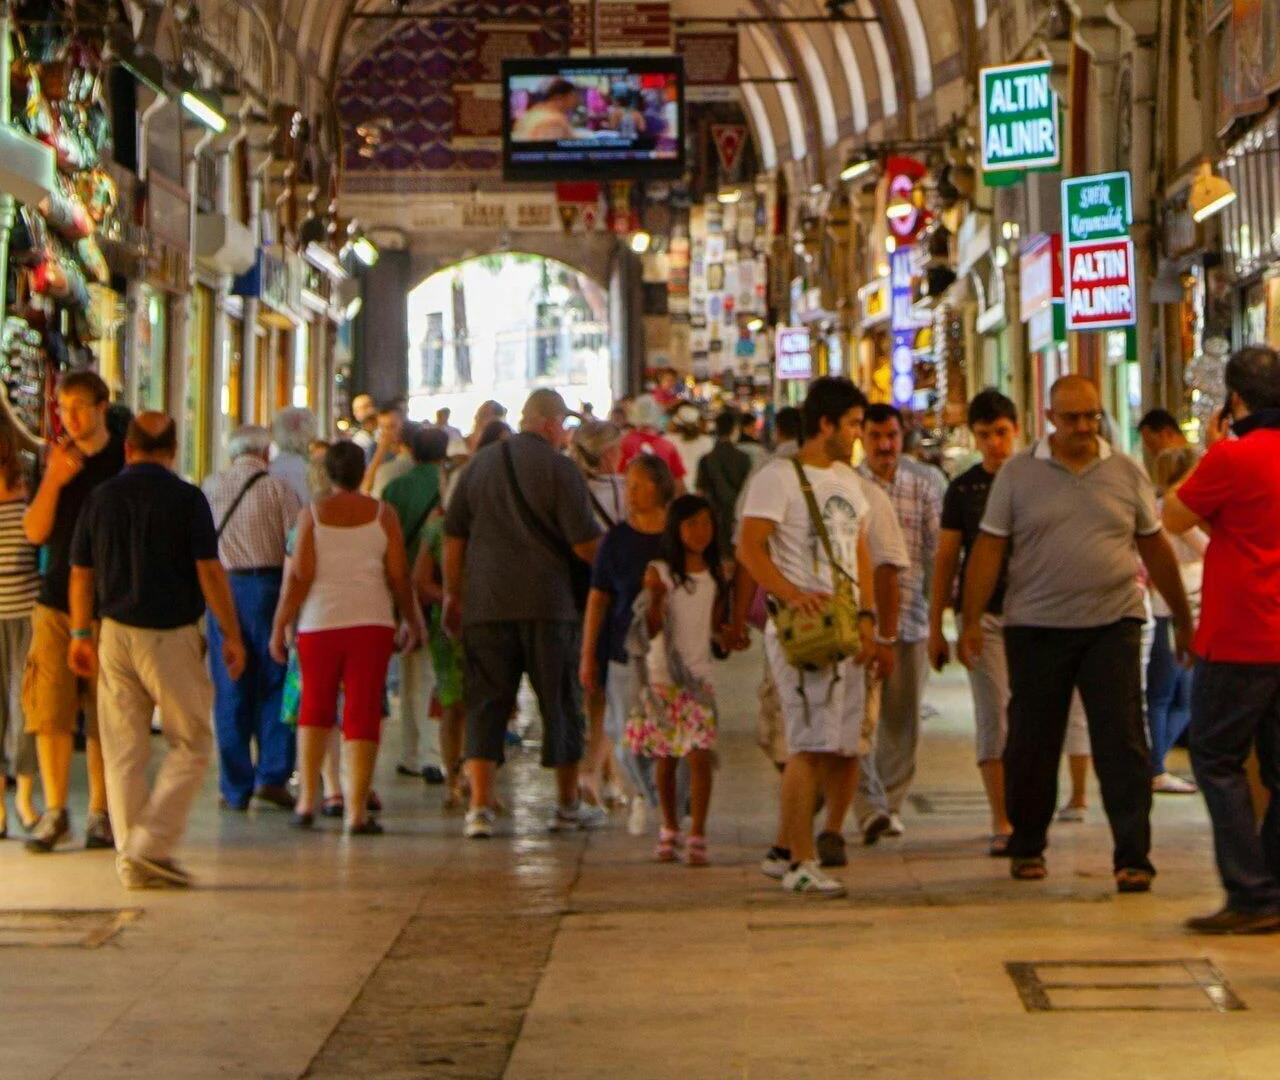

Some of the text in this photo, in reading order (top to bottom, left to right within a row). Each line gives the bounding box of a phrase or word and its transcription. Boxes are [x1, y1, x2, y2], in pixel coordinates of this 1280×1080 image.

[989, 73, 1049, 115] ALTIN
[986, 118, 1055, 159] ALINIR
[1072, 248, 1126, 282] ALTIN
[1070, 284, 1131, 317] ALINIR
